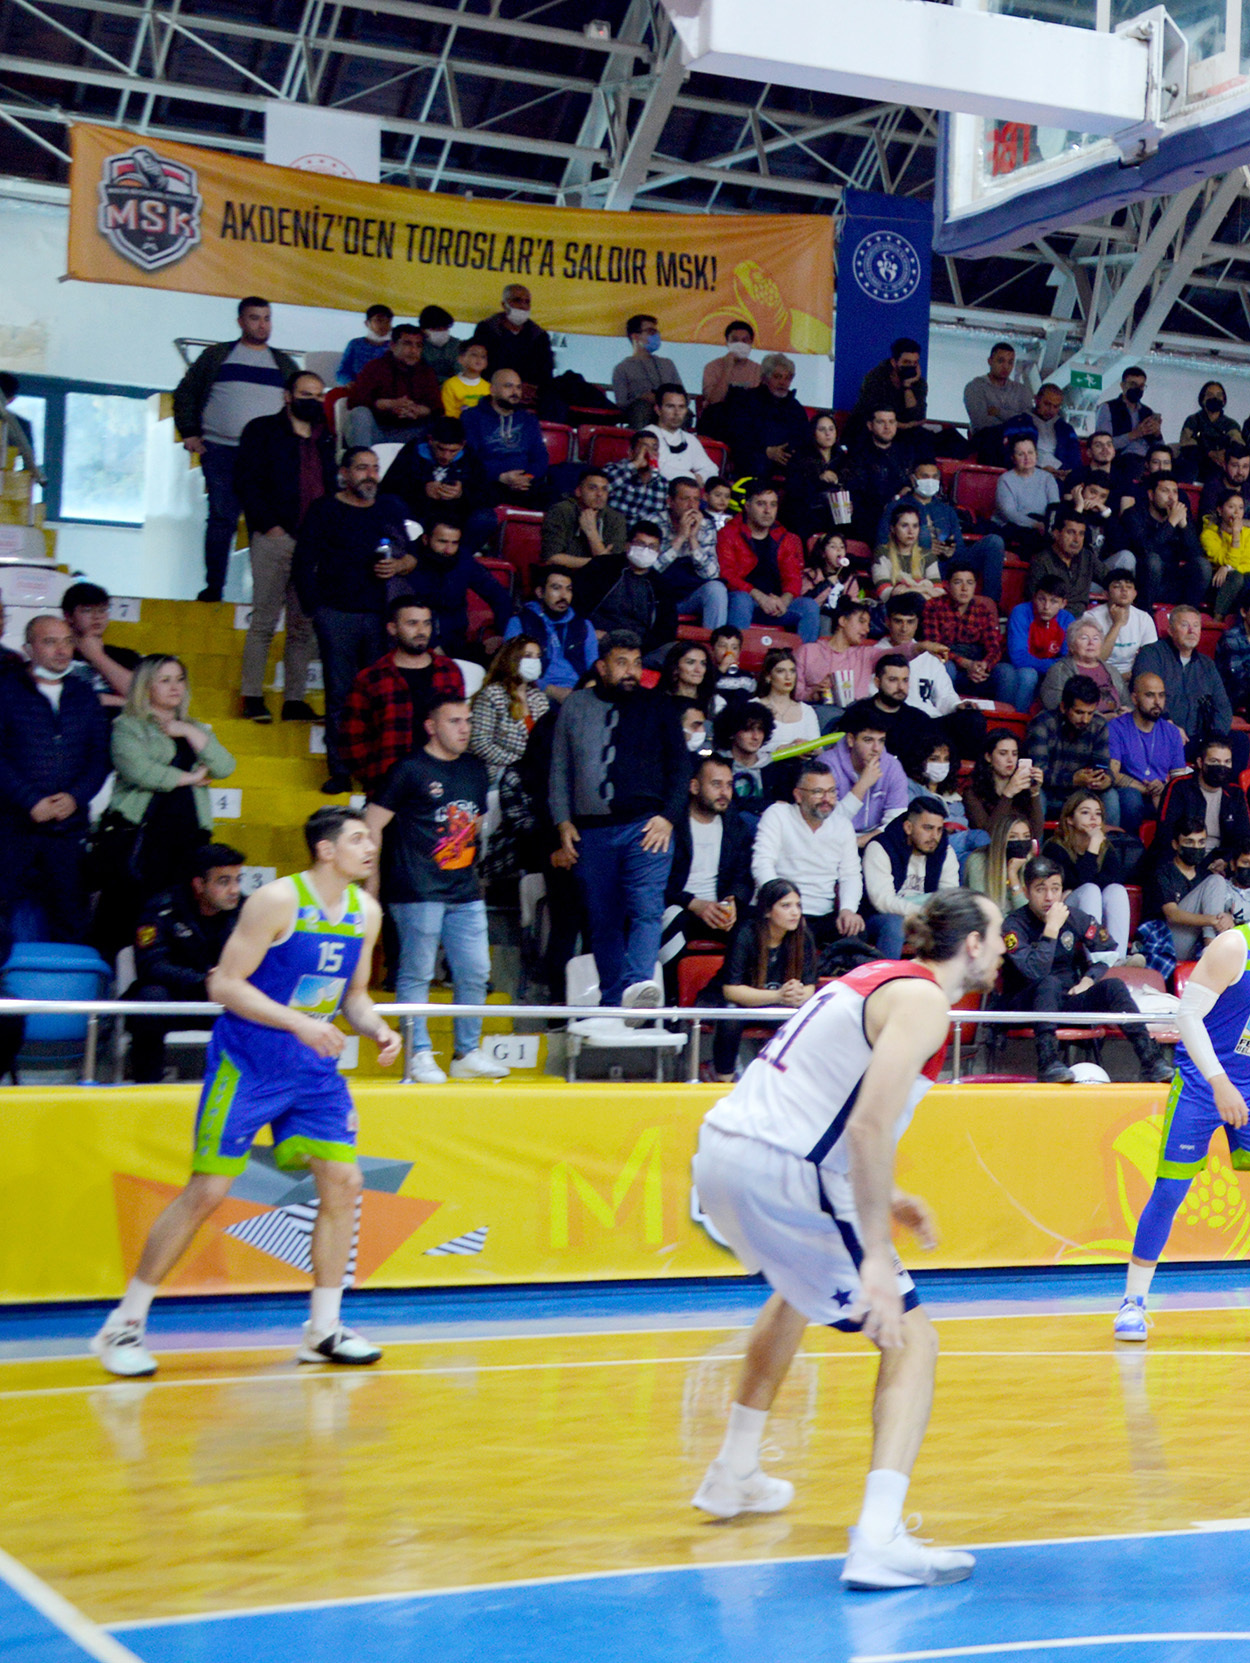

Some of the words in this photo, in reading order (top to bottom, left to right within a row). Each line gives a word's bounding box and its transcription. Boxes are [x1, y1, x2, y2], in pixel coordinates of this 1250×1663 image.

[106, 200, 195, 239] MSK
[220, 200, 396, 260] AKDENİZ'DEN
[406, 222, 555, 278] TOROSLAR'A
[563, 241, 648, 286] SALDIR
[655, 250, 717, 292] MSK!
[316, 941, 347, 974] 15
[493, 1043, 509, 1061] G
